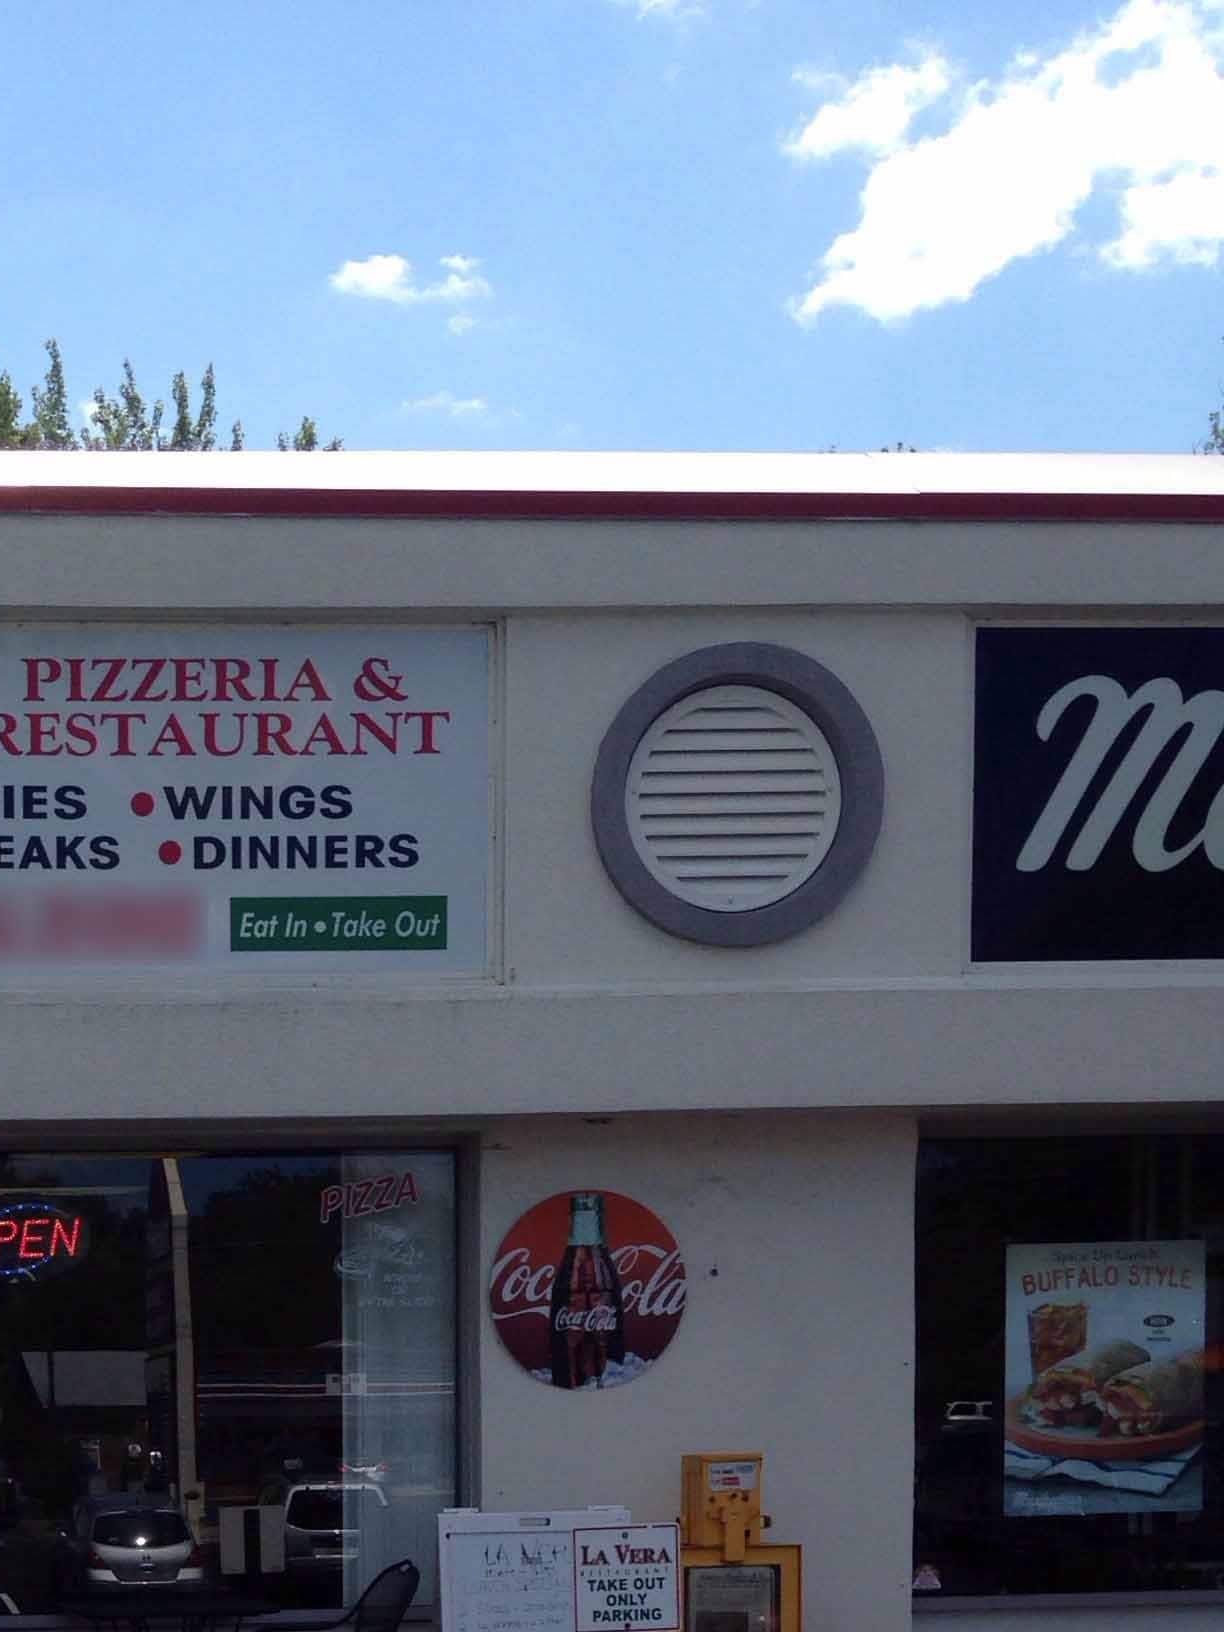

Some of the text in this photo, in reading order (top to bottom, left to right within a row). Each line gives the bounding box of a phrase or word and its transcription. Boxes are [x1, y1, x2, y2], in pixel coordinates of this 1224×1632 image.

[22, 656, 409, 703] PIZZERIA &
[163, 784, 353, 821] WINGS
[193, 833, 419, 870] DINNERS
[239, 910, 441, 939] Eat In Take Out
[320, 1173, 419, 1223] PIZZA
[1022, 1265, 1193, 1297] BUFFALO STYLE
[580, 1545, 610, 1566] LA
[614, 1544, 673, 1564] VERA
[587, 1578, 628, 1592] TAKE
[633, 1577, 666, 1590] OUT
[592, 1607, 663, 1623] PARKING
[606, 1593, 647, 1607] ONLY
